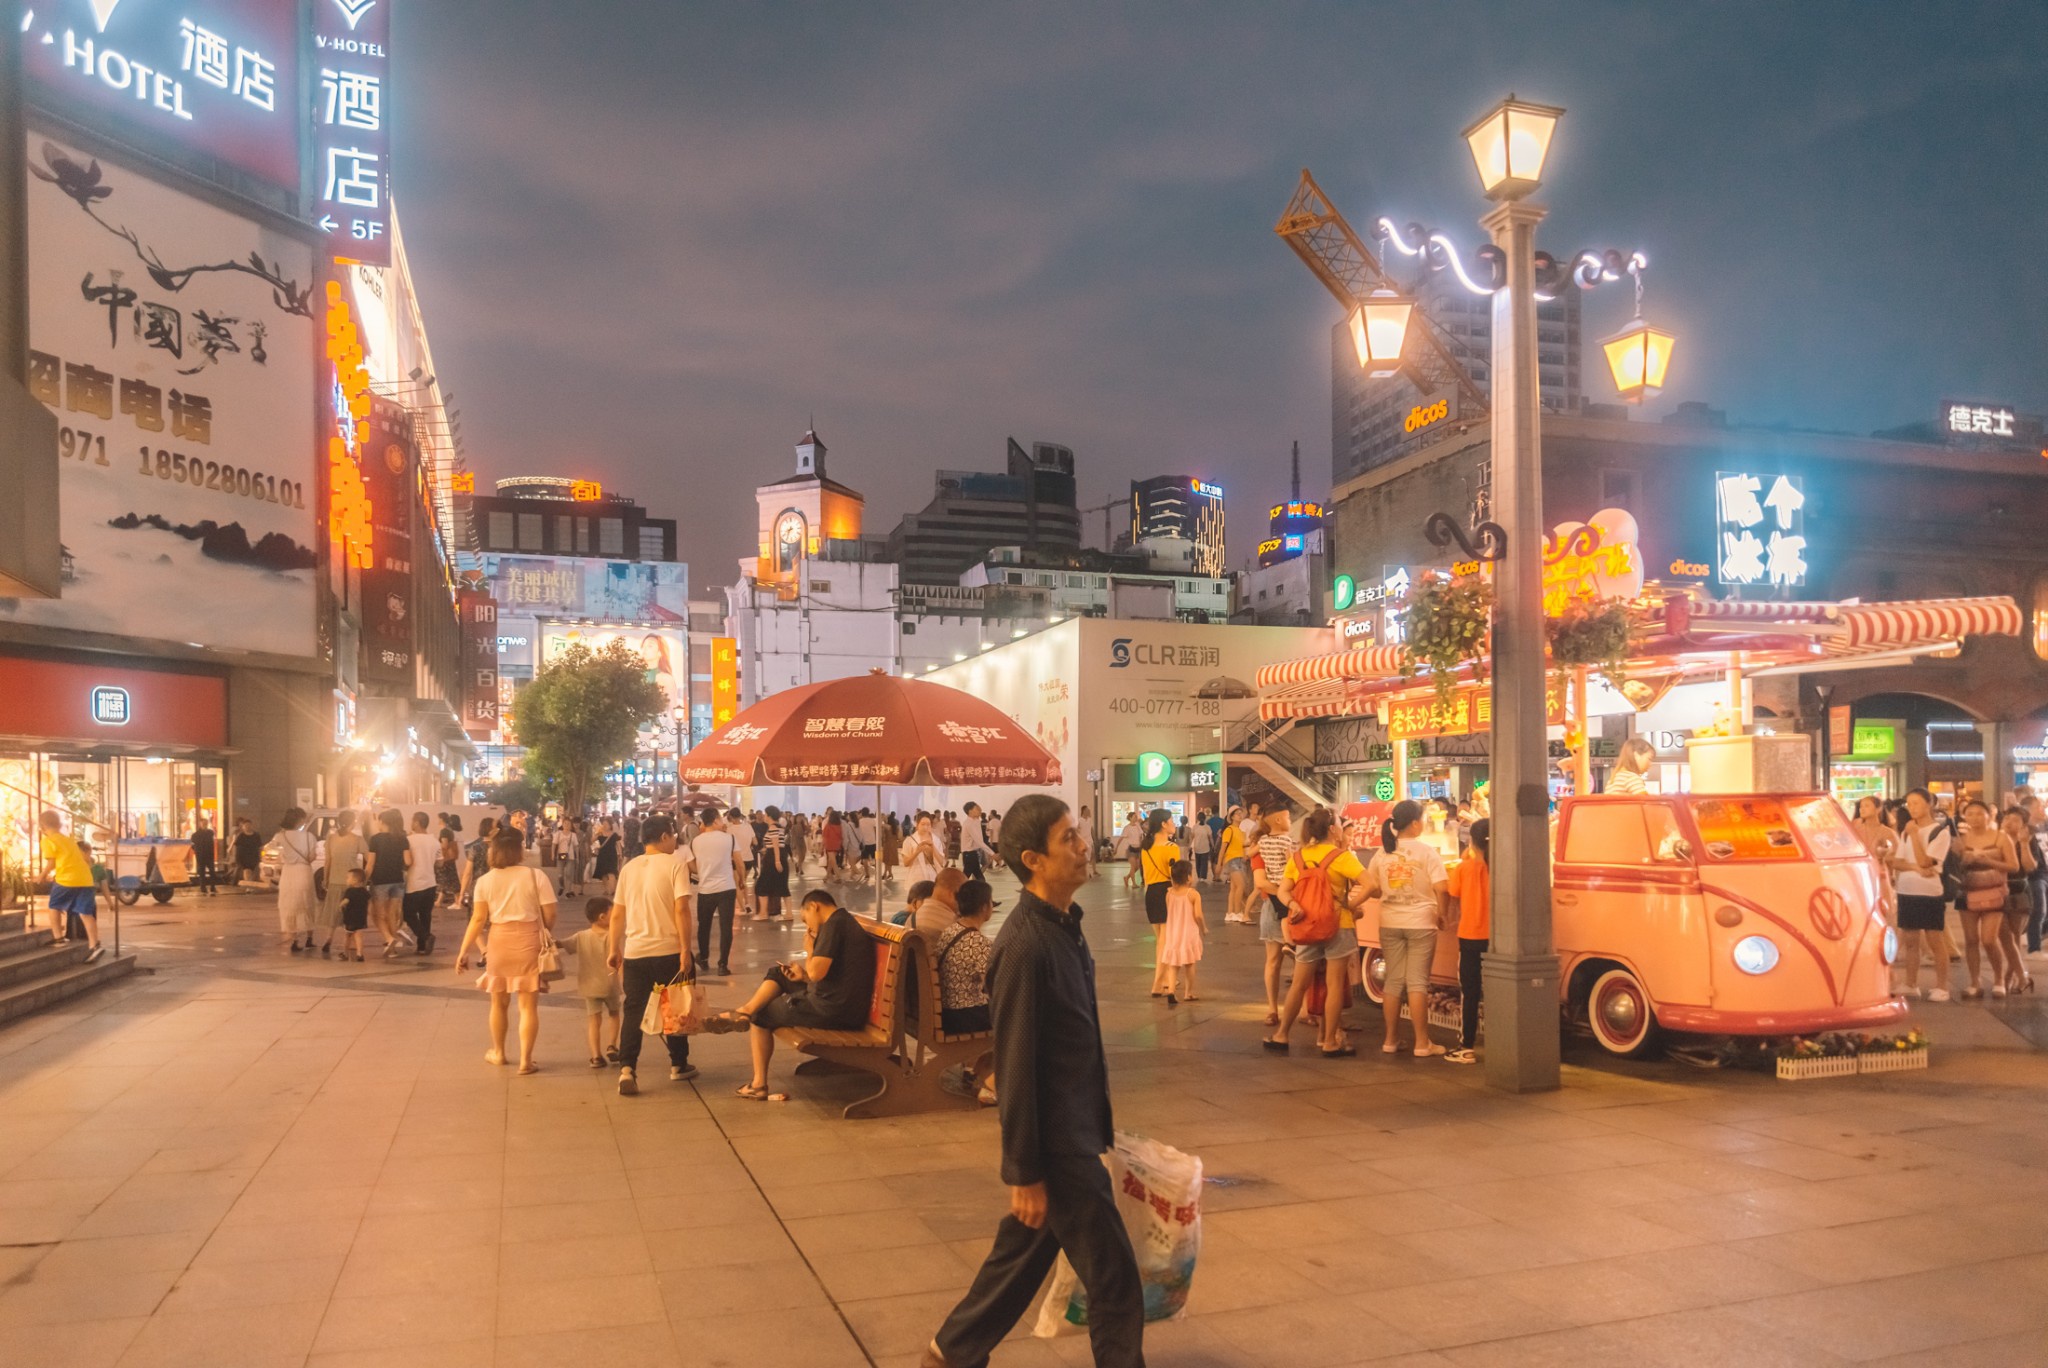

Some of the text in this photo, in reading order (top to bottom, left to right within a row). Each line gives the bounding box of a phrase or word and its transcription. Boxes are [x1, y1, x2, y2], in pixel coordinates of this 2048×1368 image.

[315, 34, 386, 58] V-HOTEL
[179, 16, 276, 112] 酒店
[320, 67, 381, 209] 酒店
[352, 219, 384, 241] 5F
[358, 266, 384, 301] KOHLER
[1404, 399, 1449, 433] dicos
[1948, 405, 2015, 437] 德克士
[138, 446, 306, 509] 18502806101
[1669, 558, 1711, 577] dicos
[1355, 584, 1386, 605] 德克士
[1344, 620, 1371, 637] dicos
[474, 603, 498, 720] 阳光百货
[1135, 644, 1220, 668] CLR 蓝润
[1109, 697, 1220, 716] 400-0777-188
[803, 731, 839, 739] Wisdom
[805, 716, 886, 732] 智慧春熙
[1661, 731, 1686, 749] Do
[1191, 772, 1217, 787] 德克士
